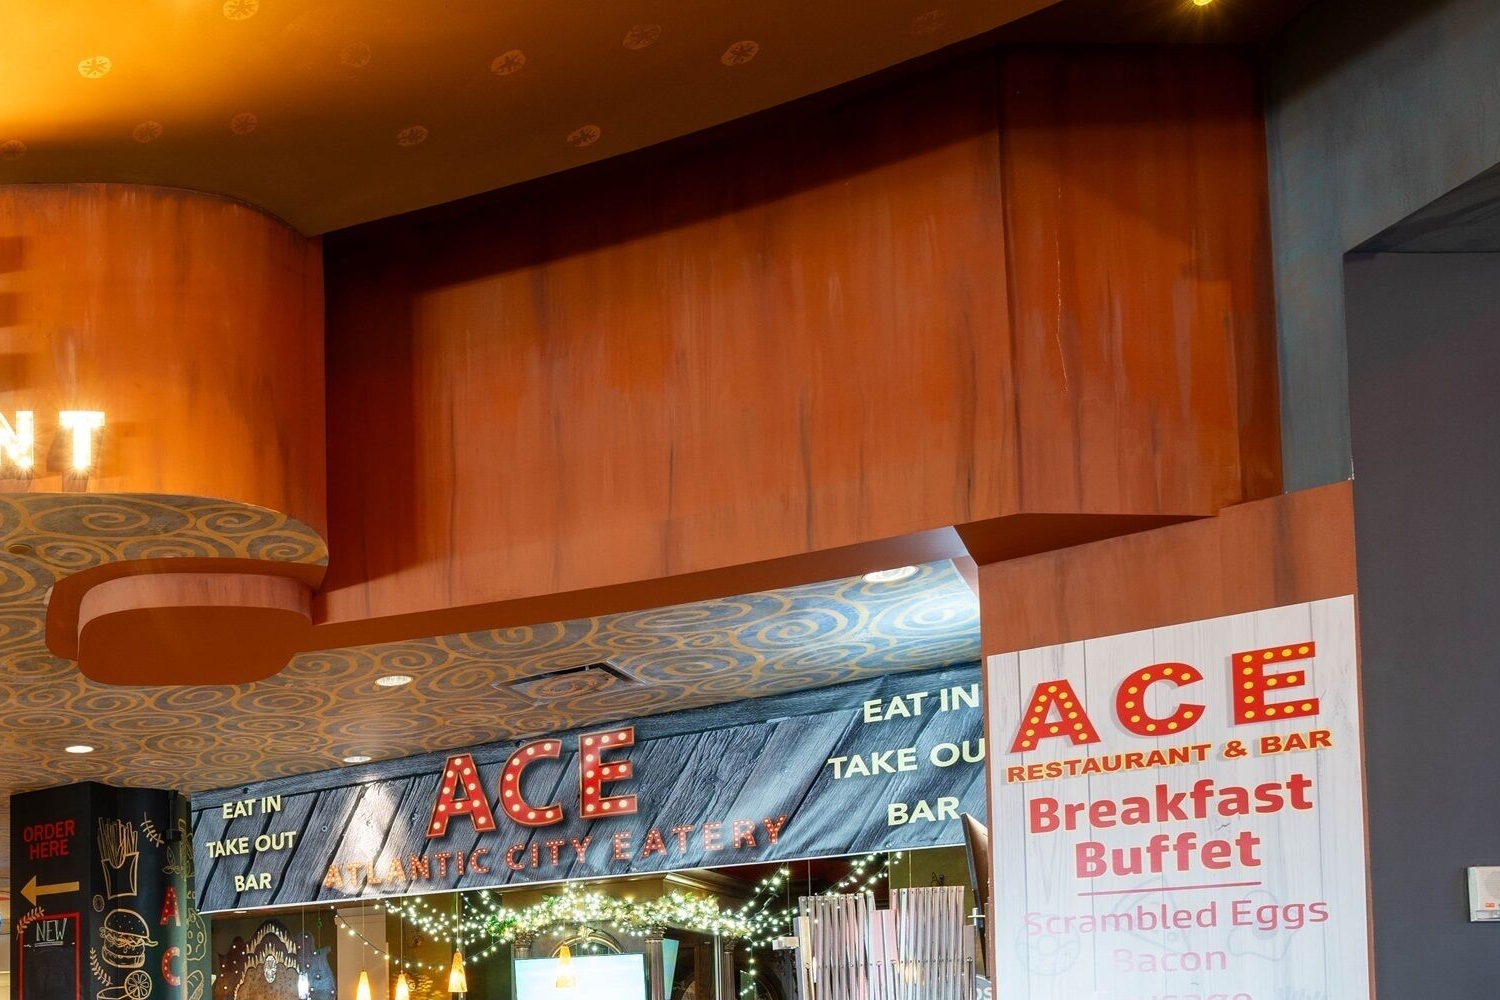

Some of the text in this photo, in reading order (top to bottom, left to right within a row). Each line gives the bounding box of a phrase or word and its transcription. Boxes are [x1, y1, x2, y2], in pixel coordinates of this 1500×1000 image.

[863, 684, 980, 723] EAT IN
[1010, 641, 1320, 753] ACE
[827, 738, 986, 779] TAKE OU
[1007, 729, 1332, 782] RESTAURANT & BAR
[426, 726, 638, 839] ACE
[223, 795, 281, 819] EAT IN
[888, 796, 961, 826] BAR
[1029, 773, 1313, 834] Breakfast
[23, 820, 76, 842] ORDER
[29, 839, 69, 859] HERE
[206, 831, 297, 859] TAKE OUT
[324, 815, 788, 889] ATLANTIC CITY EATERY
[1076, 831, 1261, 878] Buffet
[234, 872, 272, 892] BAR
[36, 918, 67, 942] NEW
[1024, 900, 1329, 936] Scrambled Eggs
[1113, 949, 1227, 973] Bacon
